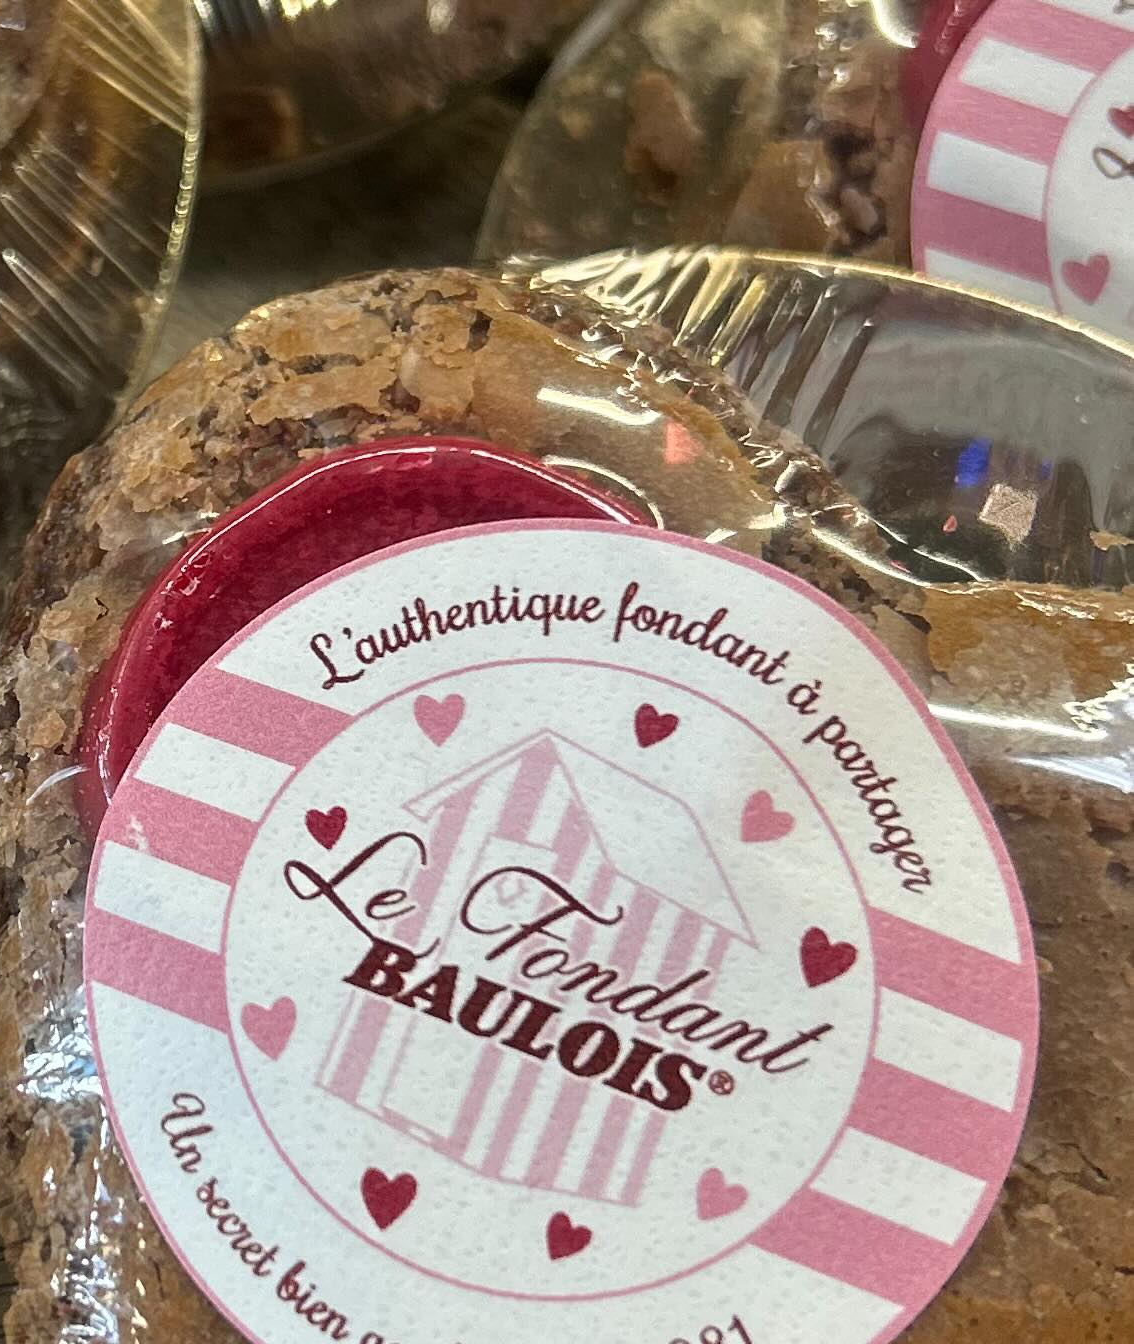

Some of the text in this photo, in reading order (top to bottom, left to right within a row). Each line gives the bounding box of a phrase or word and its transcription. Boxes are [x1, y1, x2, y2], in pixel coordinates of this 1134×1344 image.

[310, 580, 935, 896] L'authentique fondant à partager
[281, 829, 834, 1077] Le Fondant
[162, 1089, 208, 1175] Un
[197, 1174, 280, 1280] secret
[277, 1260, 350, 1342] bien
